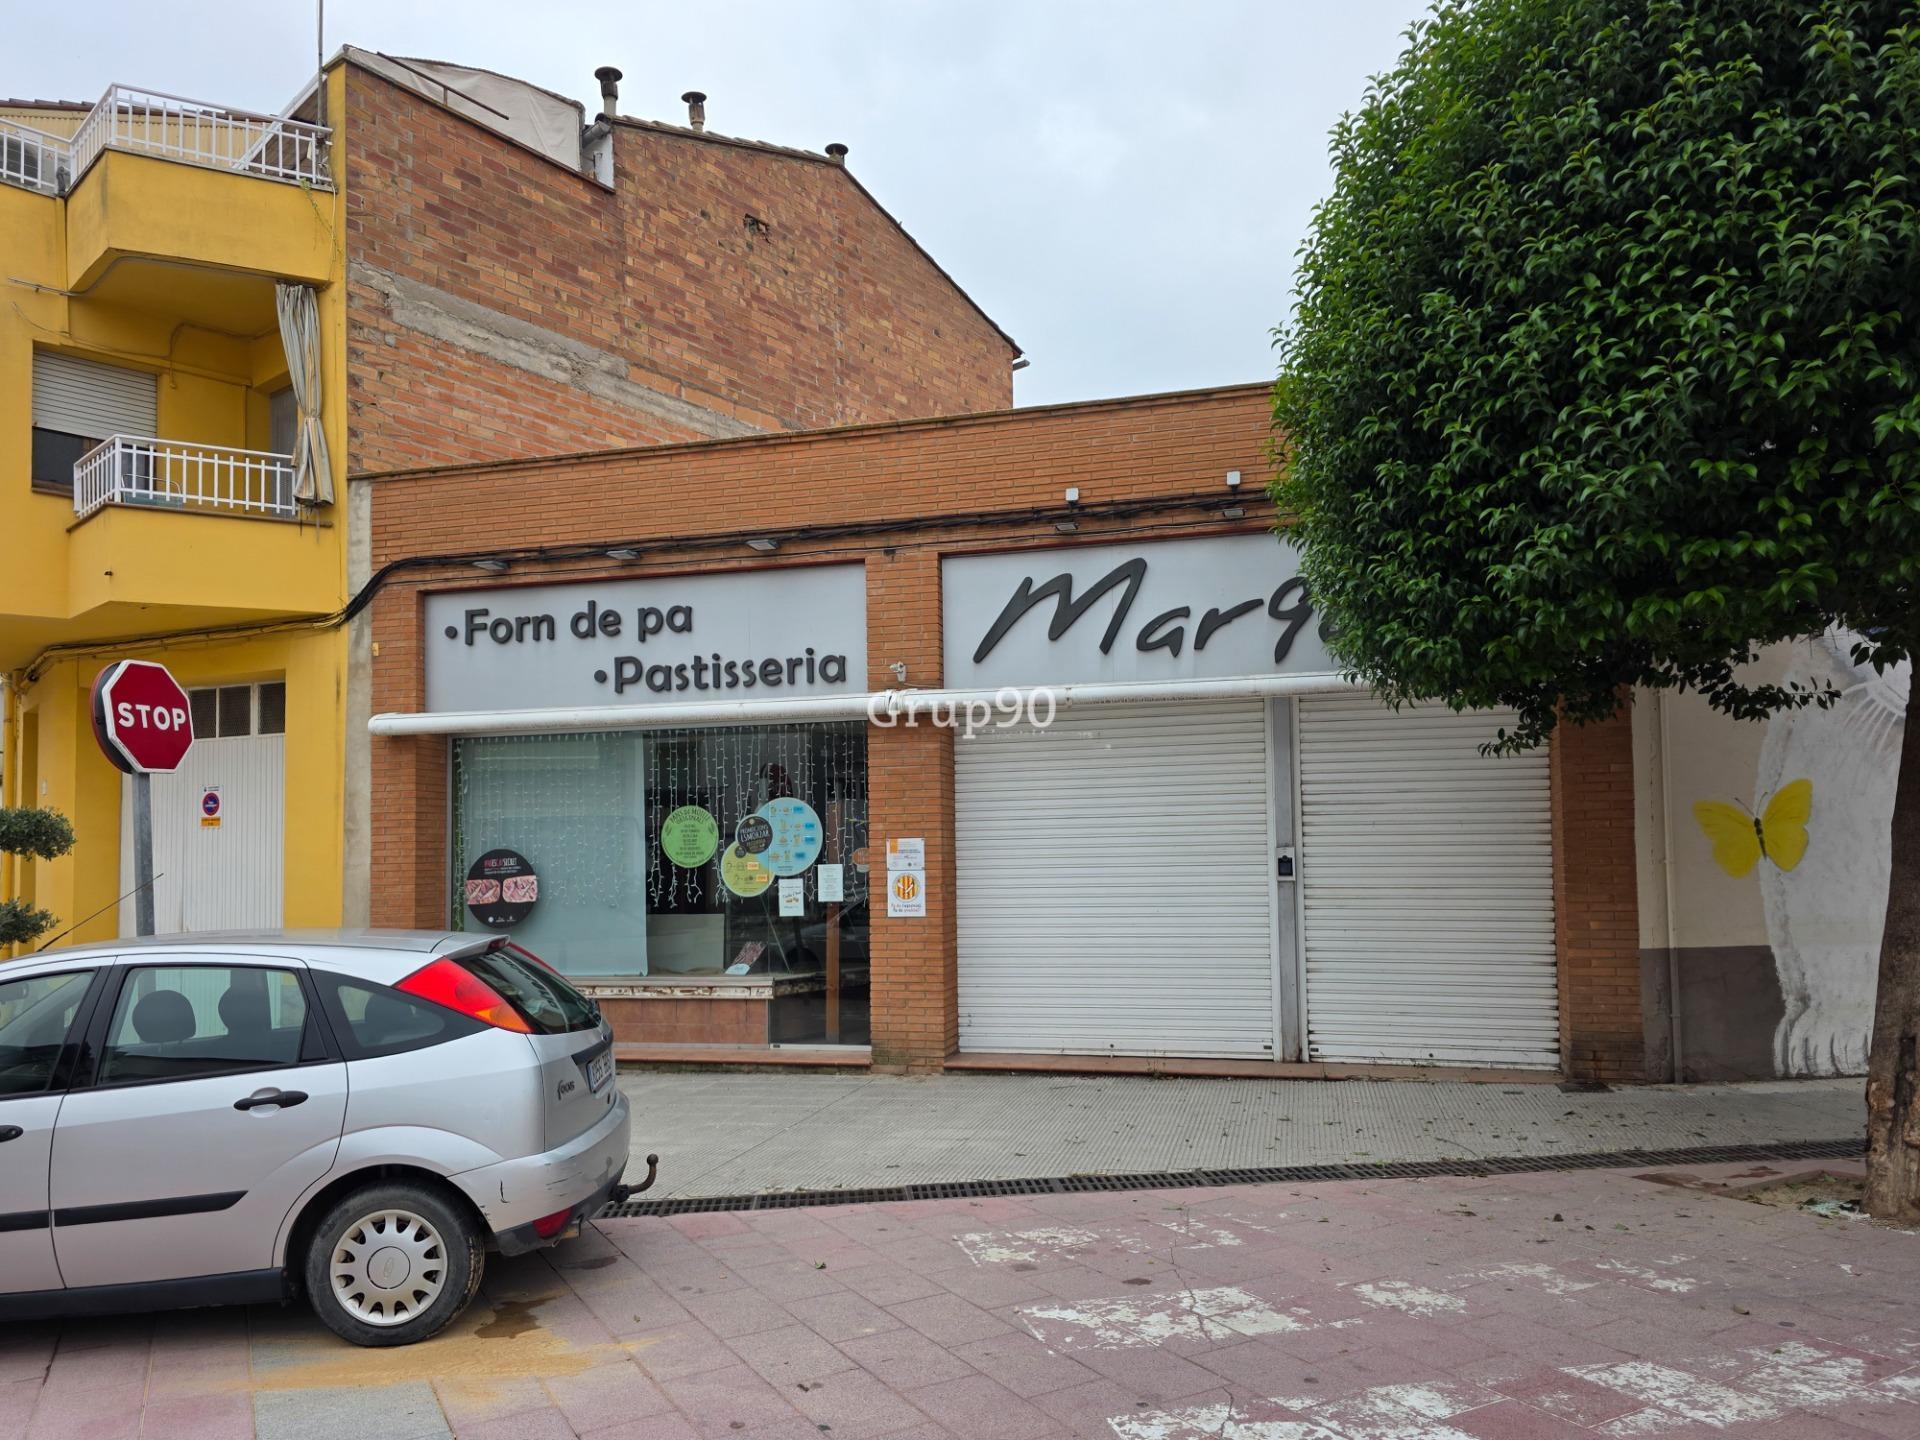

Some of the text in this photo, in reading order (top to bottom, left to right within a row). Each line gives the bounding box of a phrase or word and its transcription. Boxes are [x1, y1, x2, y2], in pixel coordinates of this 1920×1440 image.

[464, 600, 693, 646] Forn de pa
[614, 647, 847, 694] Pastisseria
[118, 702, 186, 731] STOP
